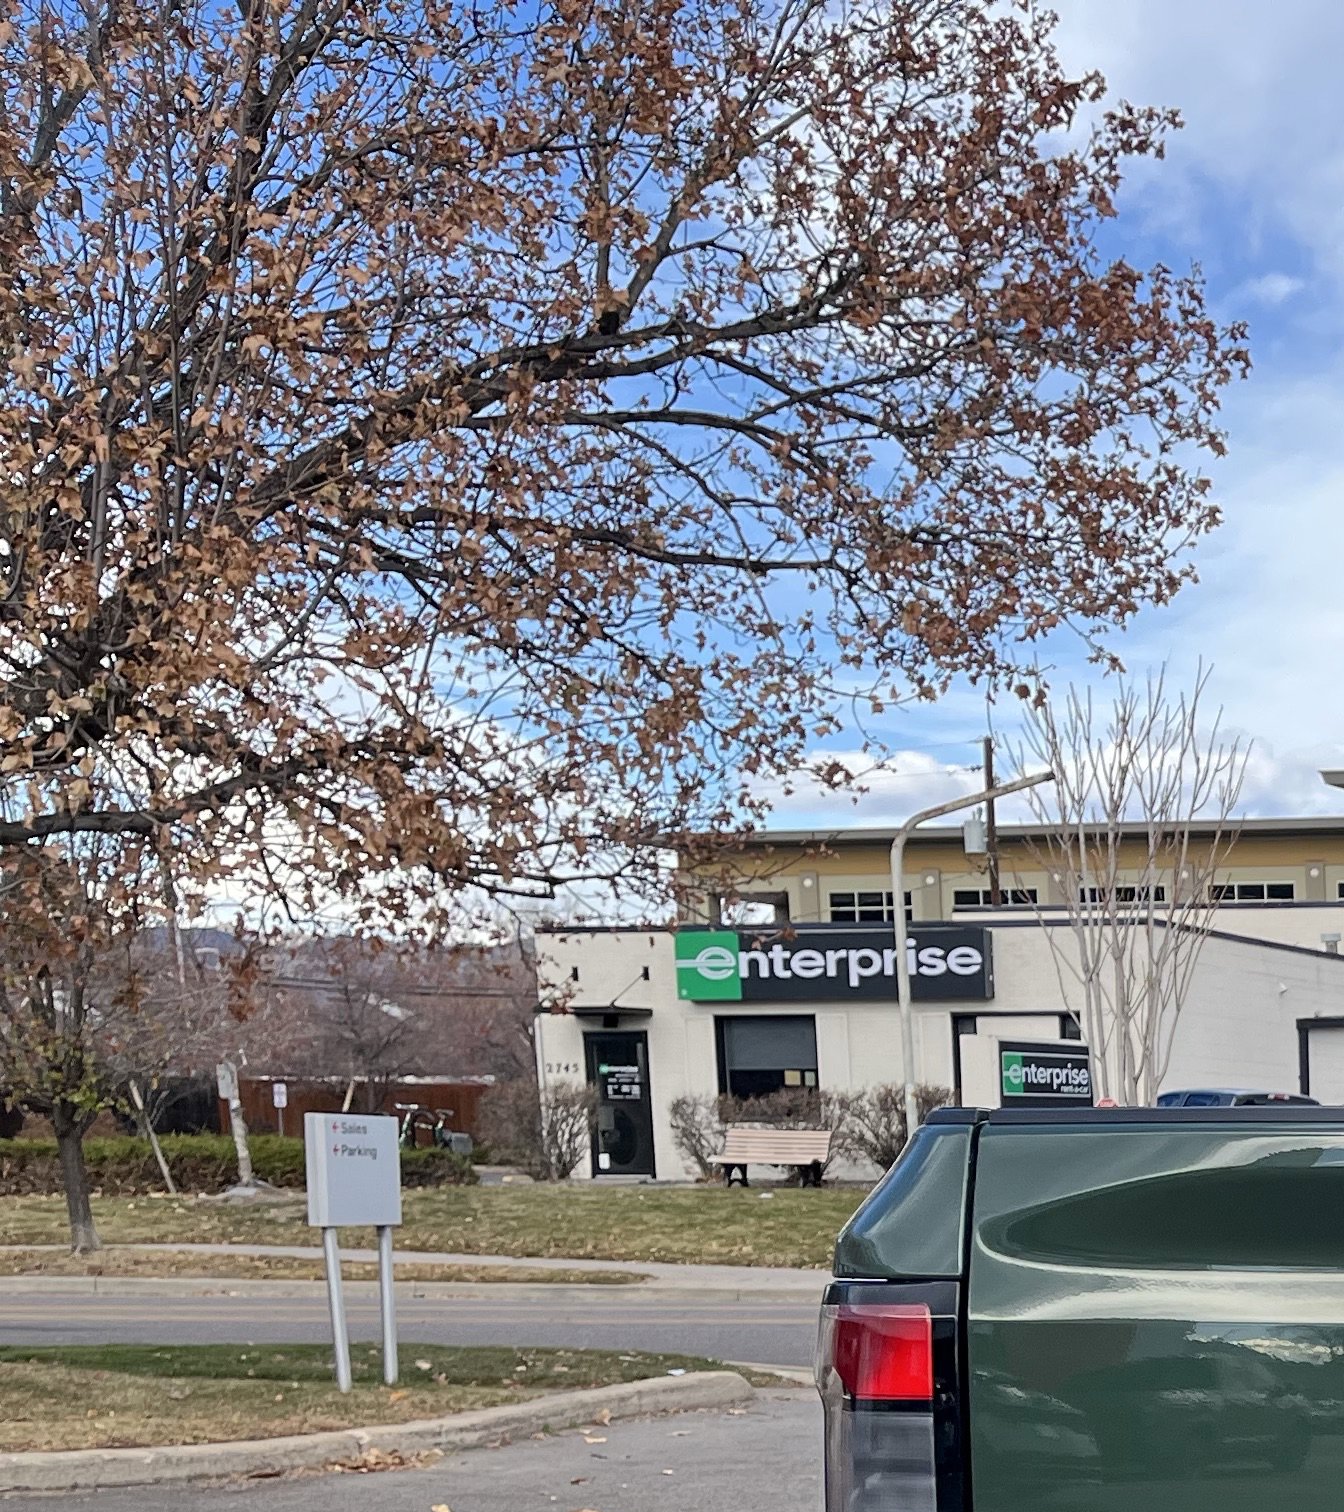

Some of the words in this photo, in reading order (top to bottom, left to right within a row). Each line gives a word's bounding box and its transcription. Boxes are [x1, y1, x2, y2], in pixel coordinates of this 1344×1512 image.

[696, 938, 983, 987] enterprise
[546, 1063, 579, 1073] 2745
[1008, 1063, 1089, 1090] enterprise
[341, 1123, 367, 1135] Sales
[341, 1145, 378, 1160] Parking
